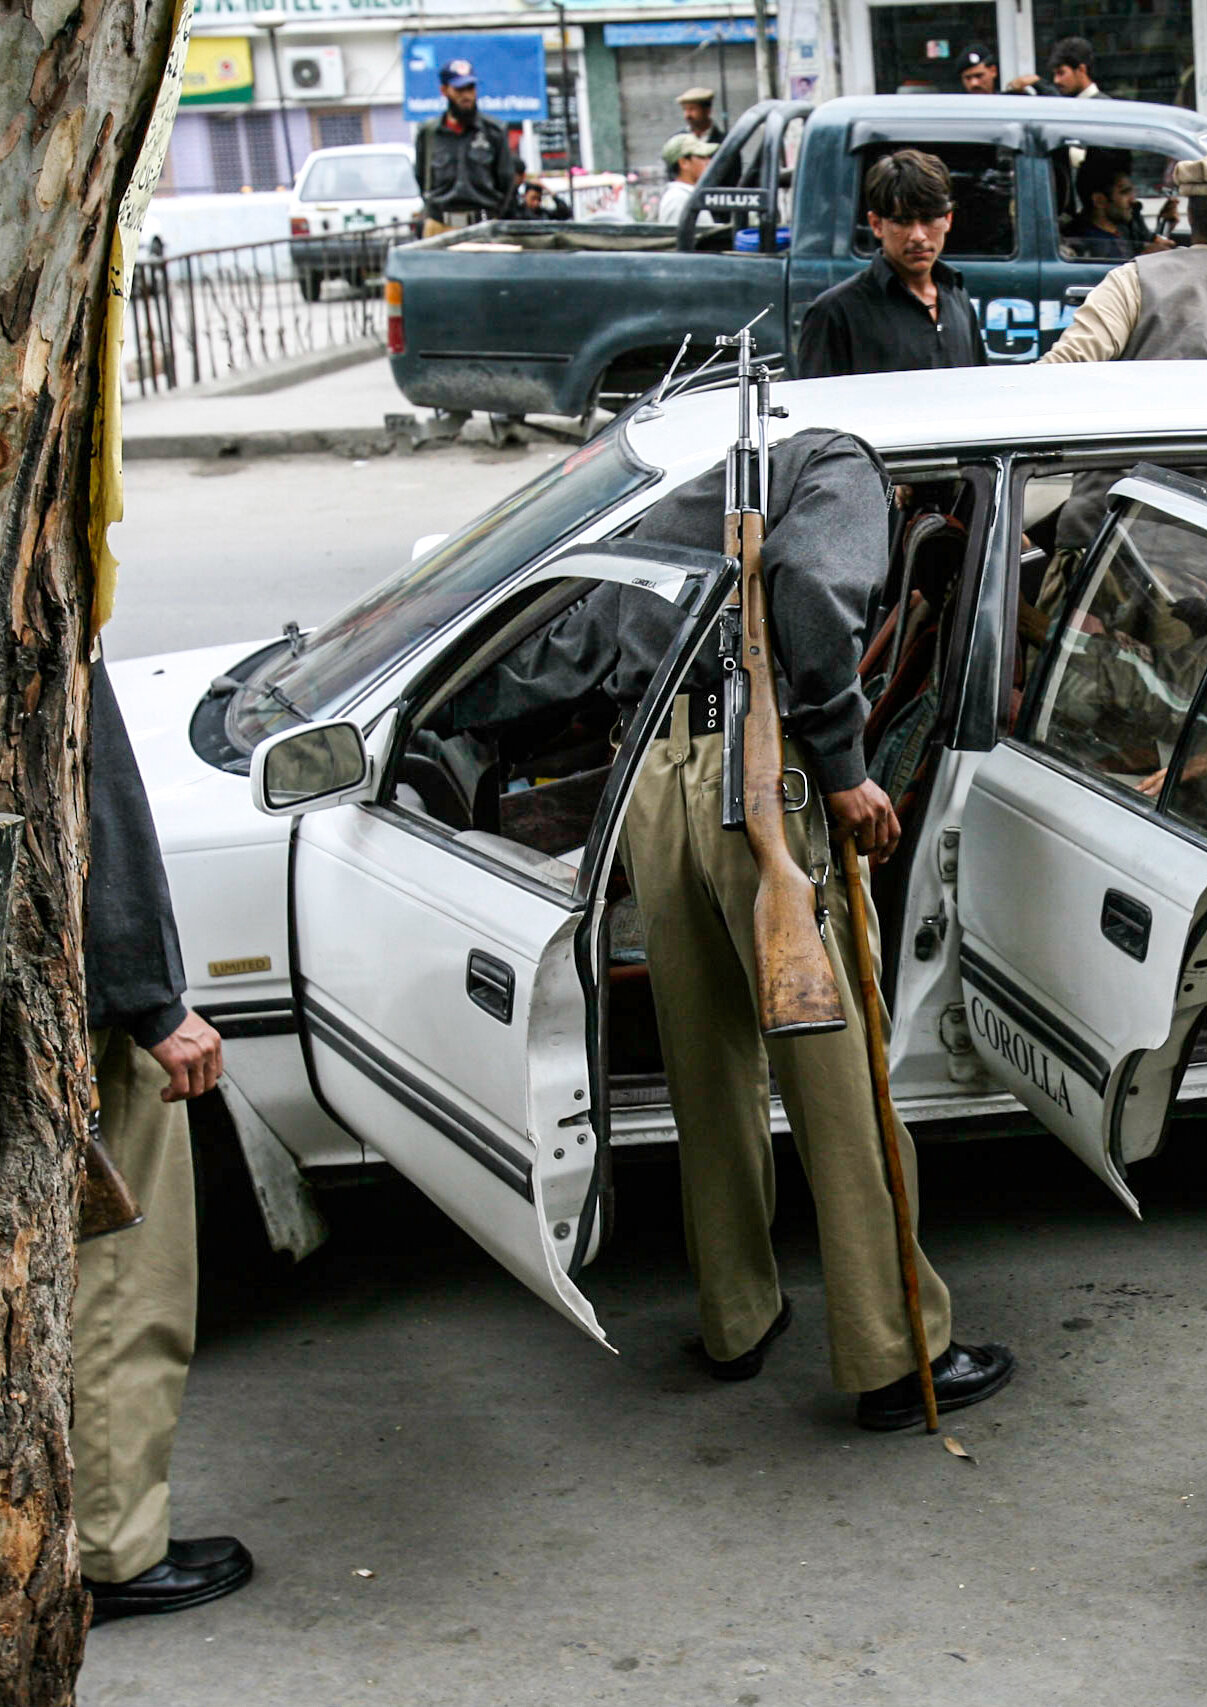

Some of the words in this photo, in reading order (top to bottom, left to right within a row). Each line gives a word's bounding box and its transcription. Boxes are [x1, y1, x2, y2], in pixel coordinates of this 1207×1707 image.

[705, 194, 760, 206] HILUX
[213, 960, 266, 974] LIMITED
[971, 996, 1074, 1117] COROLLA
